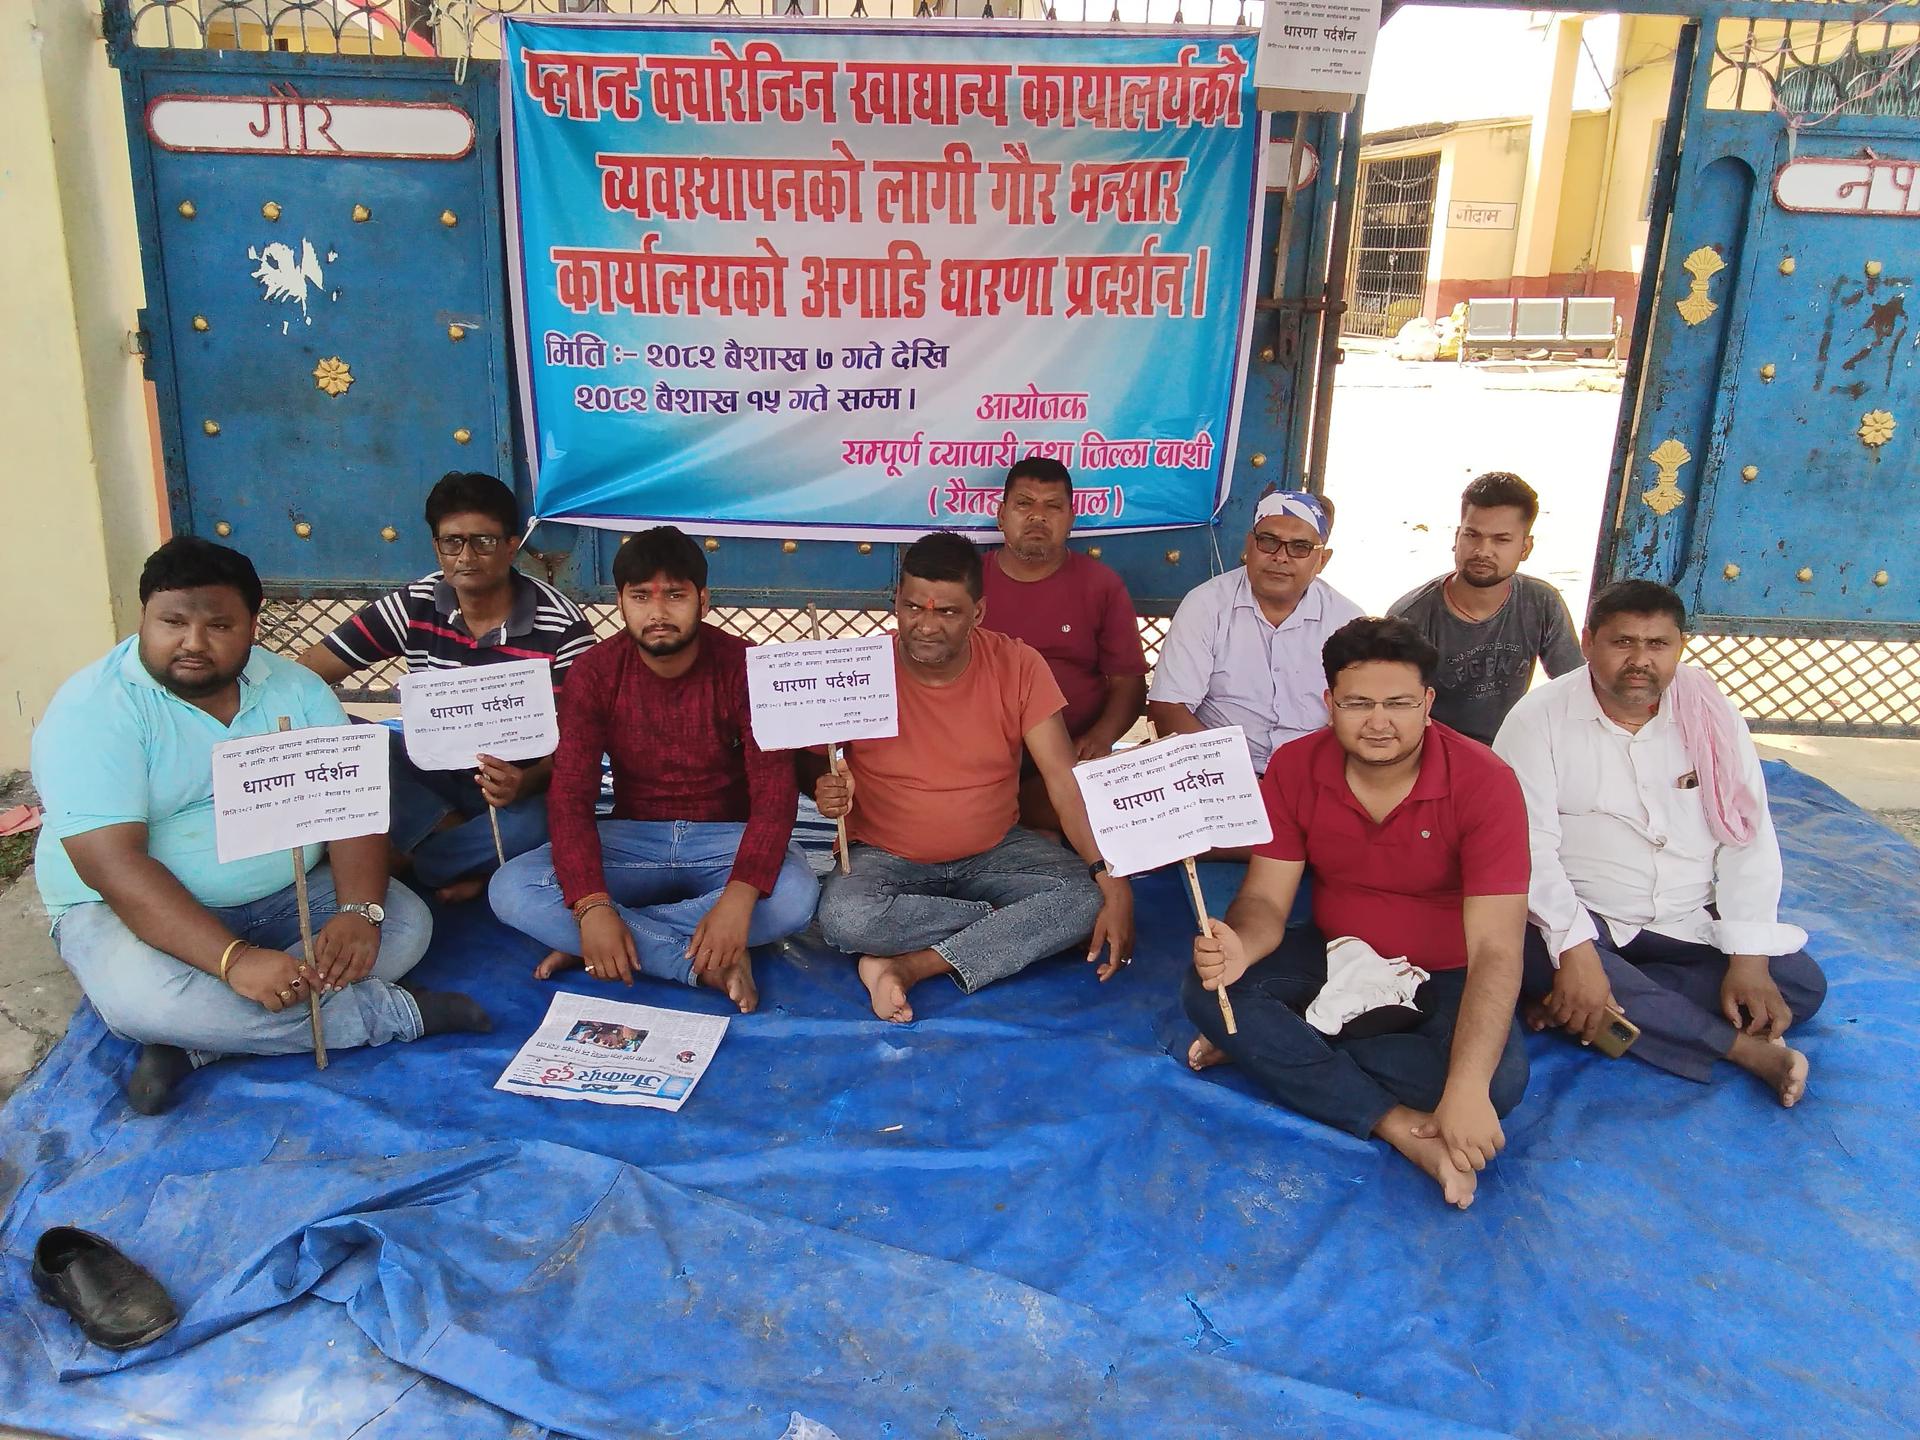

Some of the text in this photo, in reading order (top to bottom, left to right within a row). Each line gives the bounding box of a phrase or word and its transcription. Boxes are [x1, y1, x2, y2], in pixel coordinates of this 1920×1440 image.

[1284, 25, 1317, 38] धारणा
[522, 47, 641, 121] प्लान्ट
[646, 41, 839, 123] क्वारेन्टिन
[249, 81, 343, 150] गौर
[597, 139, 1188, 225] व्यवस्थापनको लागी गौर भन्सार
[552, 233, 790, 318] कार्यालयको
[801, 239, 932, 319] अगाडि
[940, 255, 1059, 318] धारणा
[545, 332, 607, 367] मिति
[647, 343, 716, 369] २०८२
[724, 338, 808, 372] बैशाख
[815, 347, 834, 370] ७
[841, 340, 885, 370] गते
[891, 337, 950, 371] देखि
[576, 386, 648, 411] २०८२
[655, 380, 740, 414] बैशाख
[746, 389, 782, 414] १५
[788, 383, 831, 412] गते
[837, 388, 902, 412] सम्म
[976, 383, 1089, 421] आयोजक
[841, 431, 925, 477] सम्पूर्ण
[928, 430, 1019, 468] व्यापारी
[1081, 431, 1152, 469] जिल्ला
[1156, 433, 1214, 469] वाशी
[772, 678, 816, 692] धारणा
[430, 704, 473, 719] धारणा
[243, 773, 295, 794] धारणा
[1113, 787, 1165, 811] धारणा
